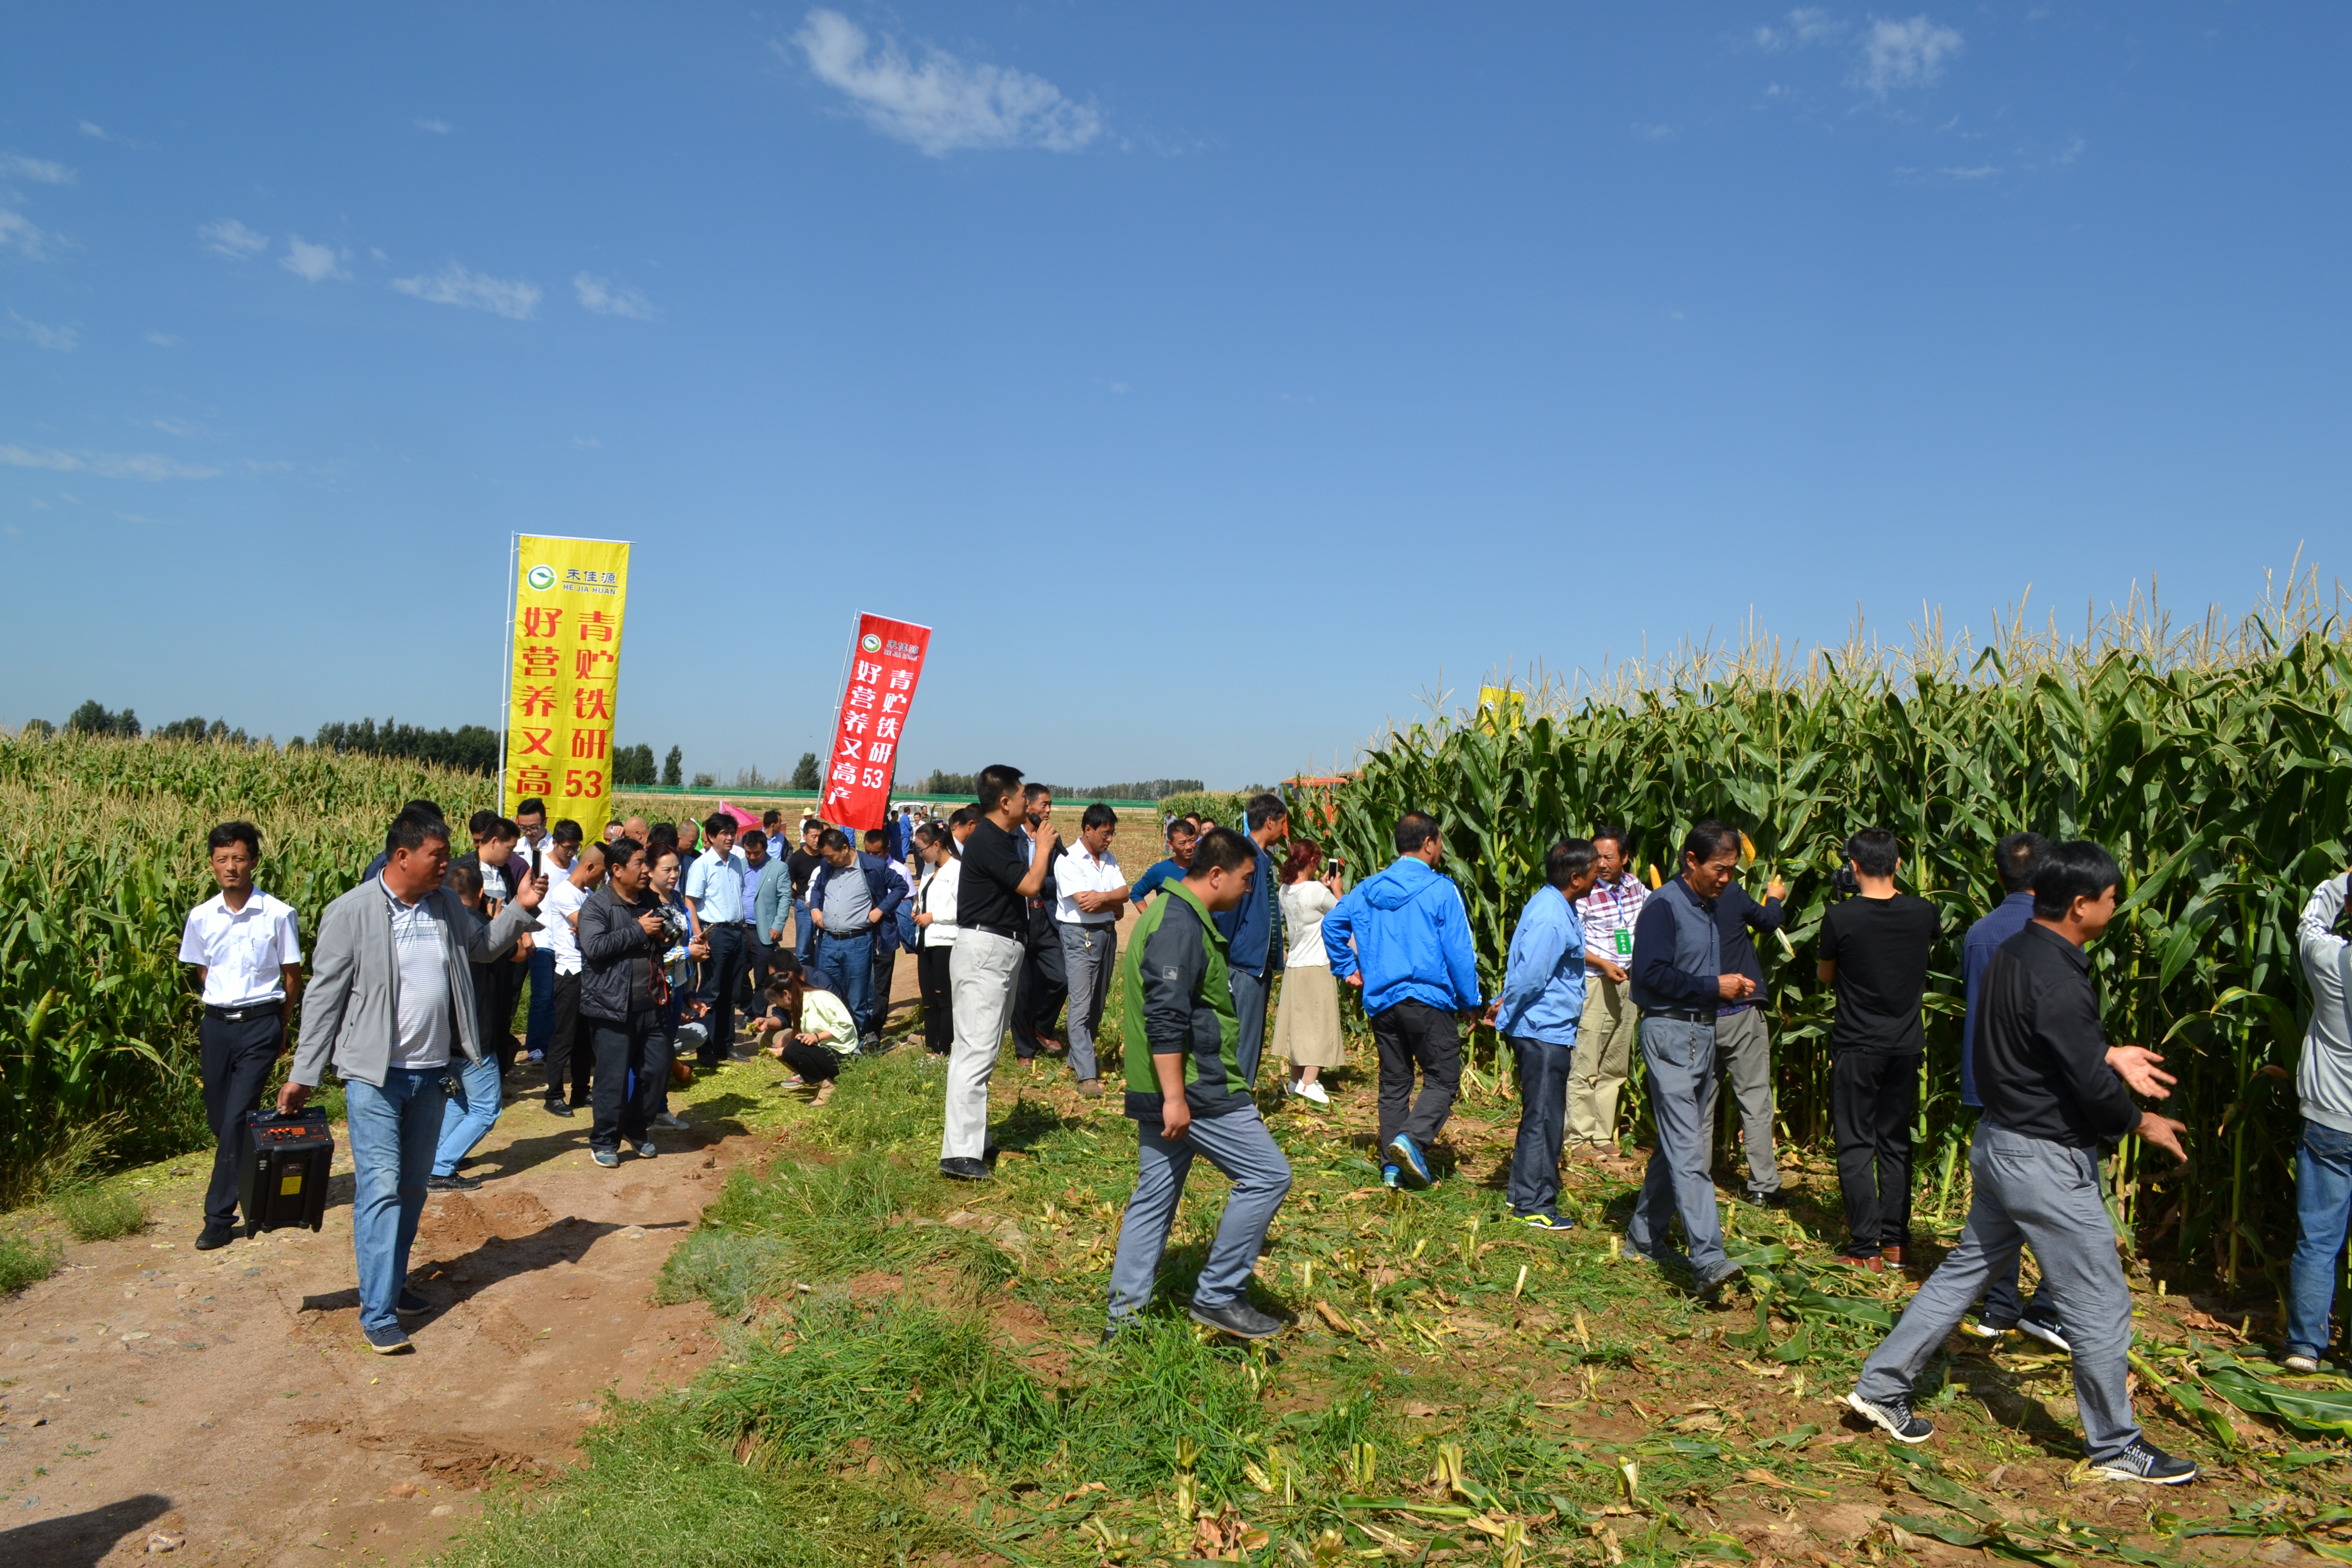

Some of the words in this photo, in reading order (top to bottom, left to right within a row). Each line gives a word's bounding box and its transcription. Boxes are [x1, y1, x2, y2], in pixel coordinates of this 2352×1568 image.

[566, 569, 616, 584] 禾佳源
[515, 606, 562, 825] 好营养又高
[565, 610, 616, 798] 青贮铁研53
[828, 659, 883, 805] 好营养又高产
[862, 669, 914, 789] 青贮铁研53
